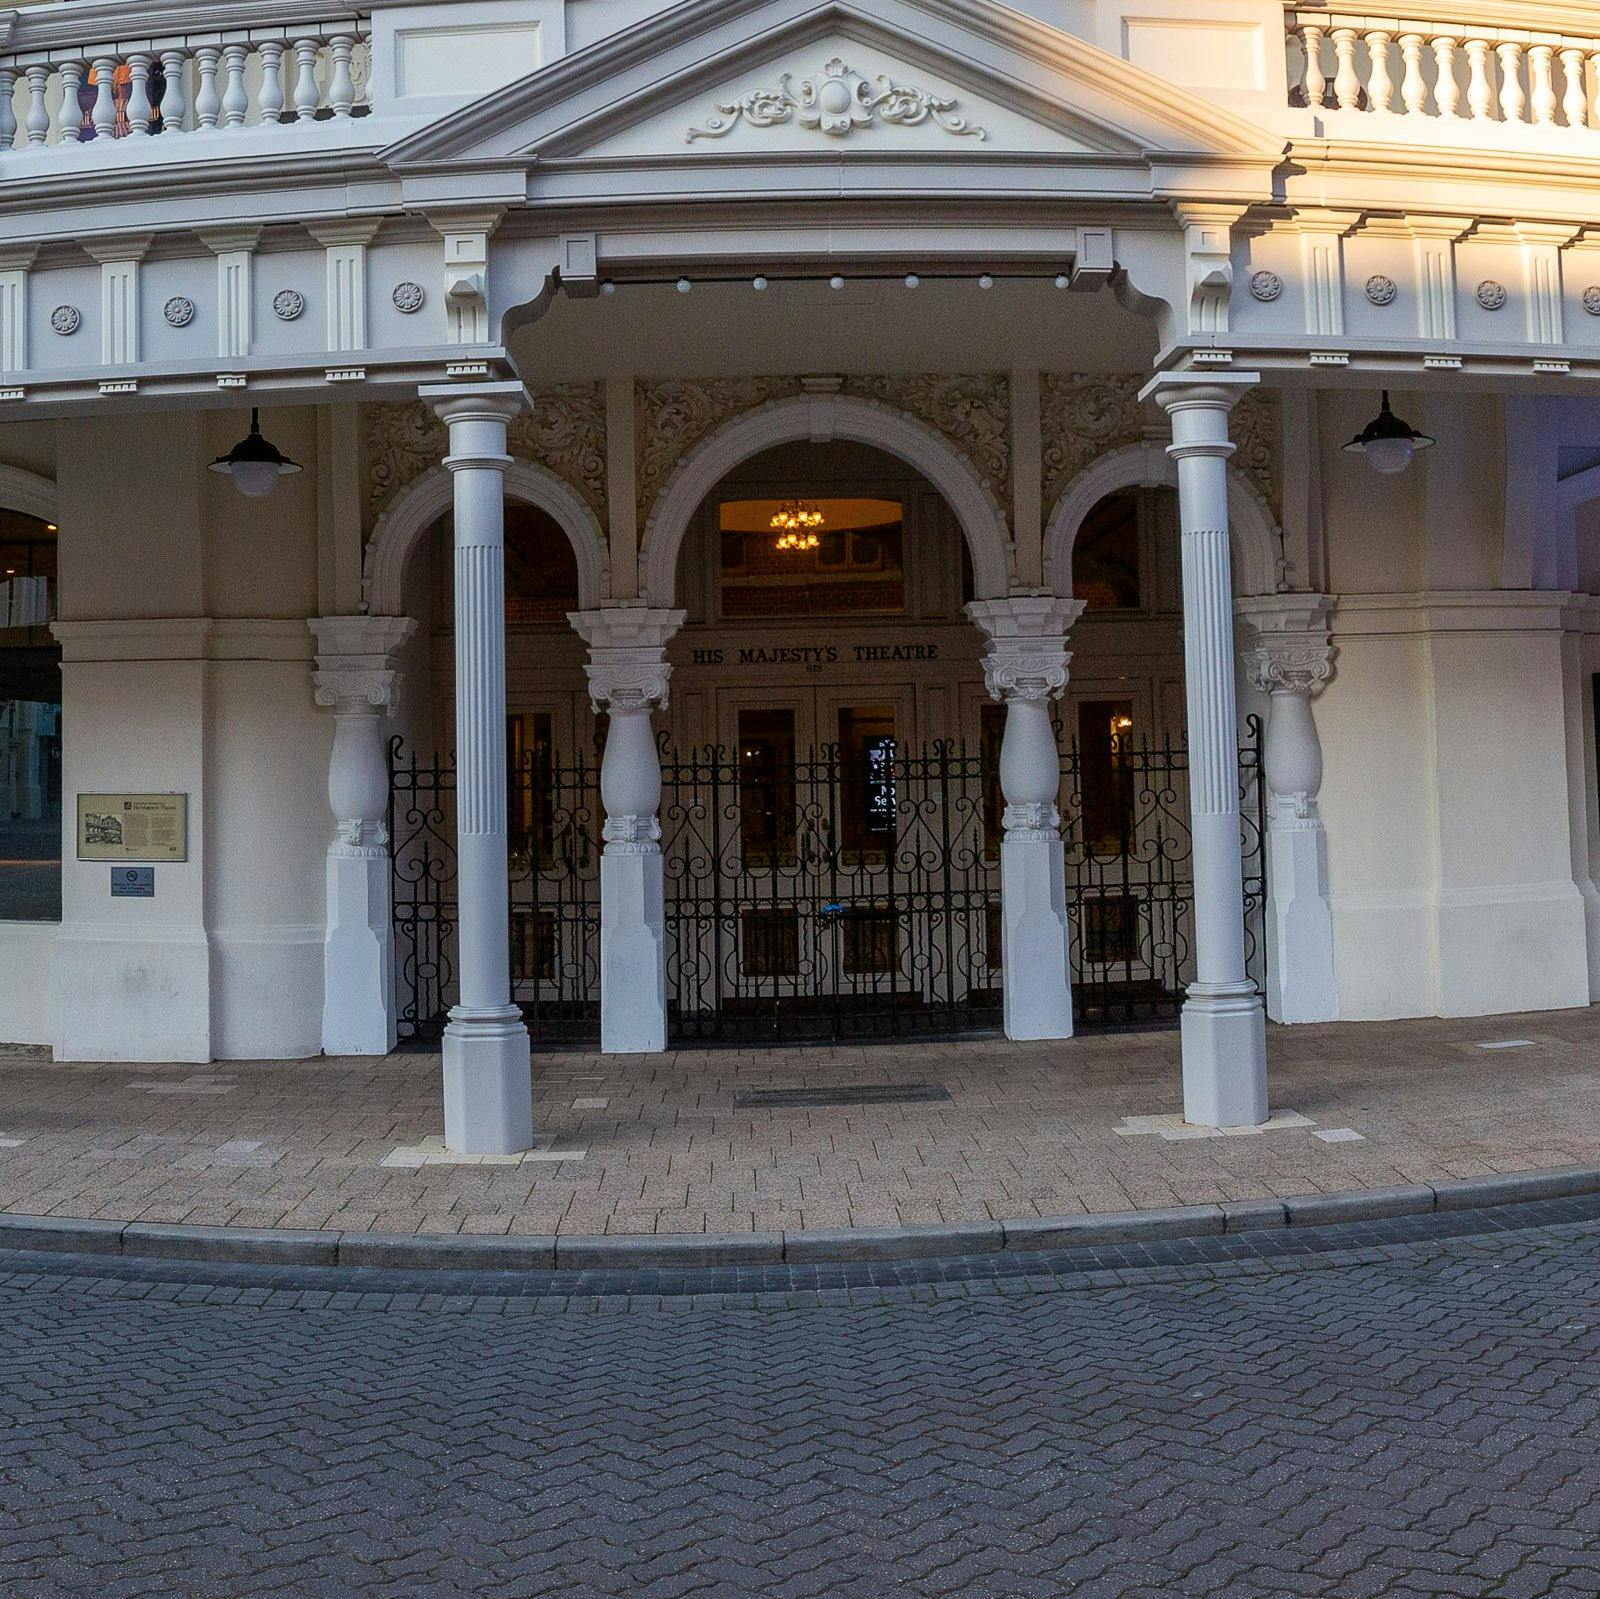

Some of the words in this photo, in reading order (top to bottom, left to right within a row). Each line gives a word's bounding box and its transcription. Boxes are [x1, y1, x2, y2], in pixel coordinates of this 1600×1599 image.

[693, 649, 724, 664] HIS
[738, 646, 838, 664] MAJESTY'S
[854, 645, 938, 661] THEATRE
